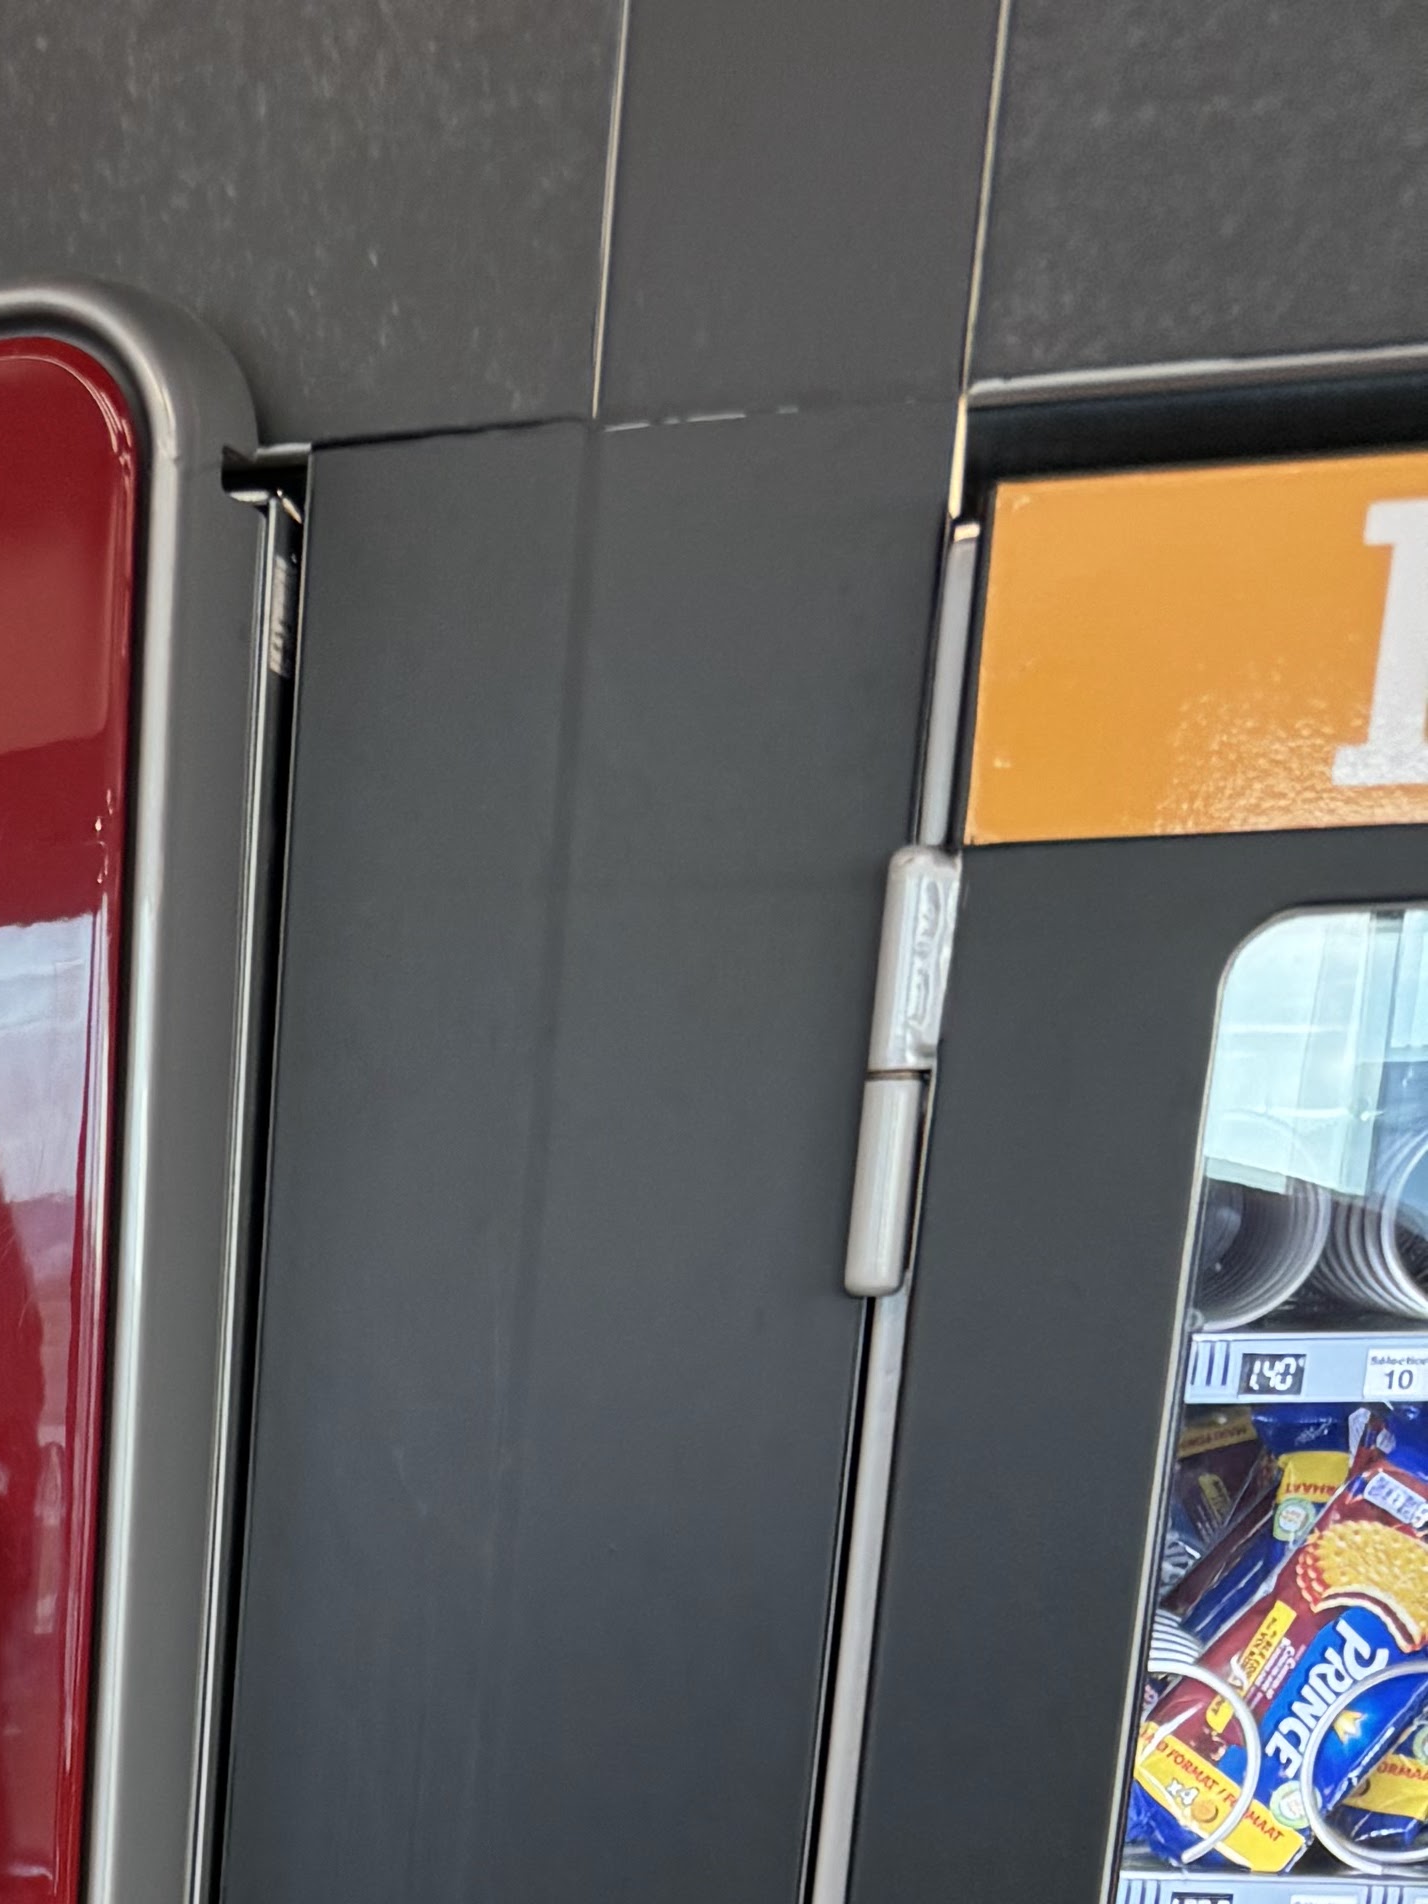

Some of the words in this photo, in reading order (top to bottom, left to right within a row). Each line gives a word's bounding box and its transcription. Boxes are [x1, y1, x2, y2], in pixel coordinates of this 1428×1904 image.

[1385, 1369, 1414, 1390] 10
[1265, 1617, 1390, 1779] PRINCE
[1166, 1748, 1219, 1790] FORMAT
